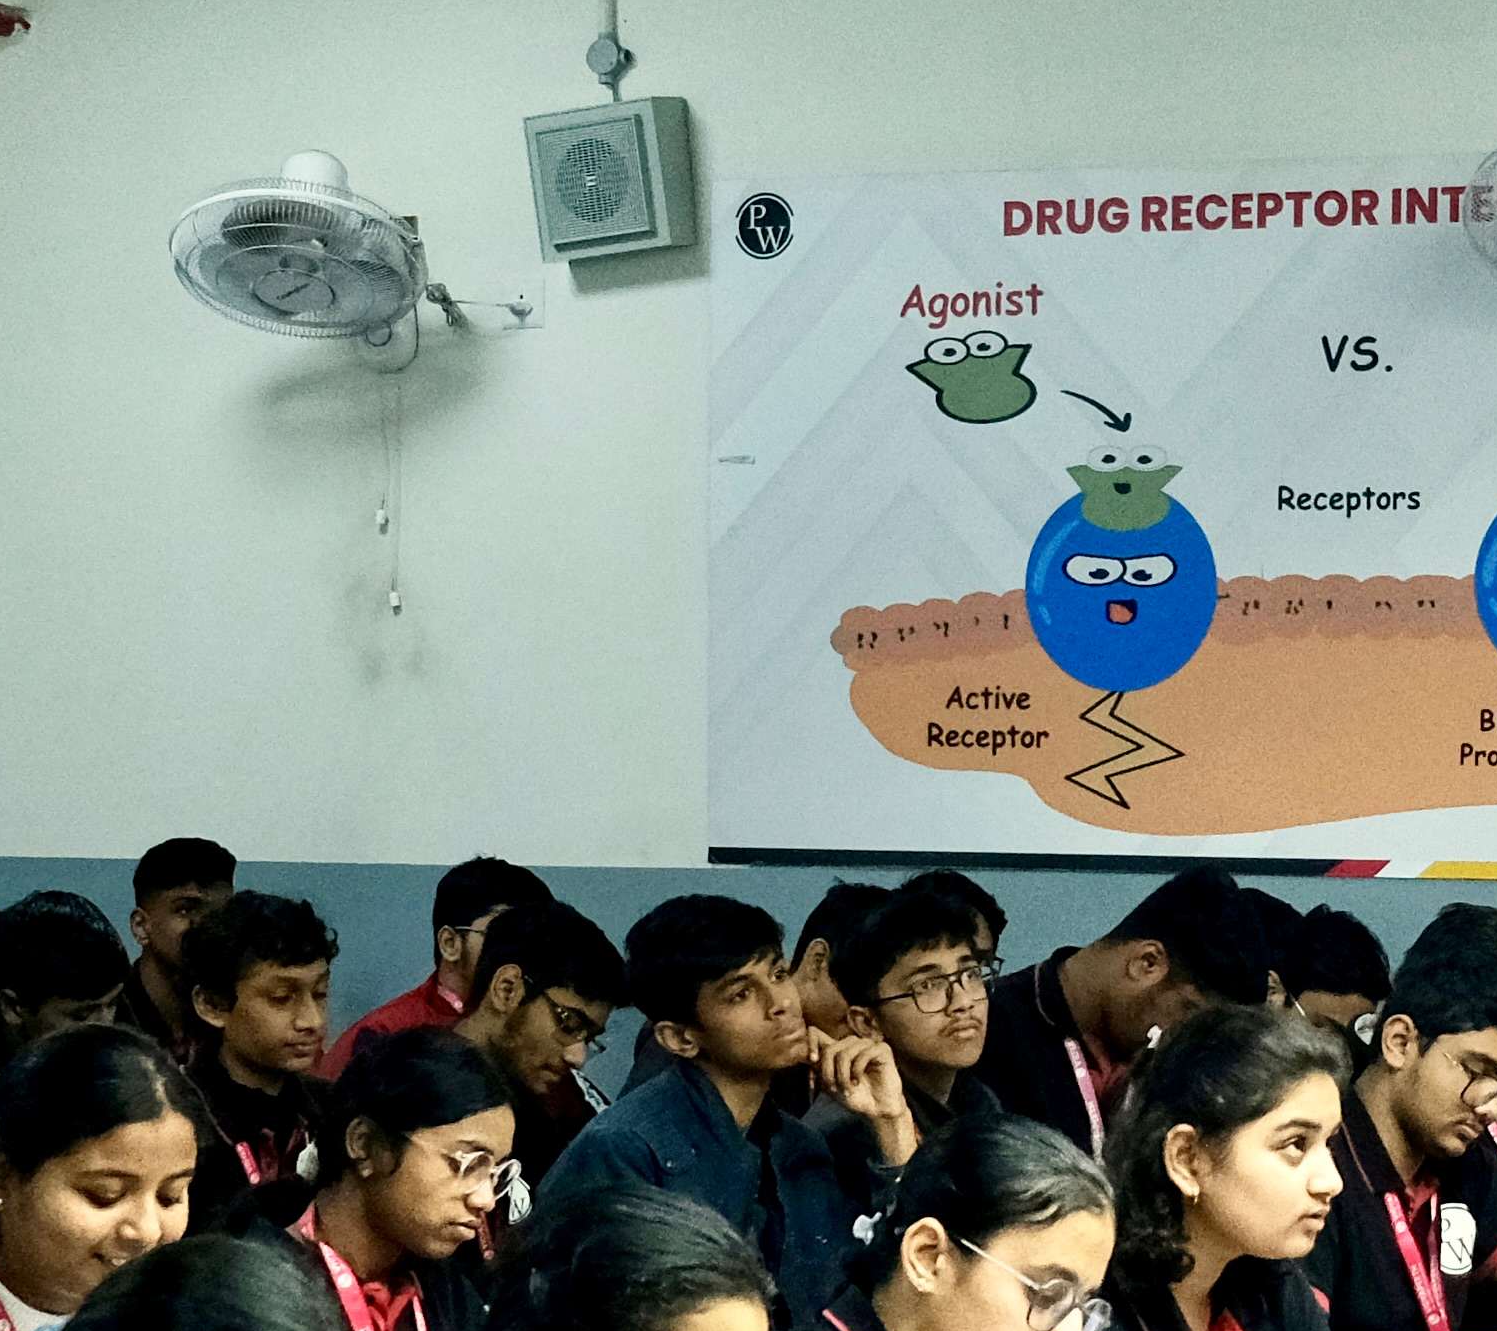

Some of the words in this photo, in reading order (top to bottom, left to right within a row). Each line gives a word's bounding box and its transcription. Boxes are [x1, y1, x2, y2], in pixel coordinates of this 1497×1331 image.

[1003, 197, 1130, 236] DRUG
[1141, 188, 1379, 232] RECEPTOR
[900, 281, 1044, 328] Agonist
[1321, 334, 1394, 372] VS.
[1277, 484, 1421, 519] Receptors
[945, 685, 1031, 710] Active
[927, 722, 1050, 756] Receptor
